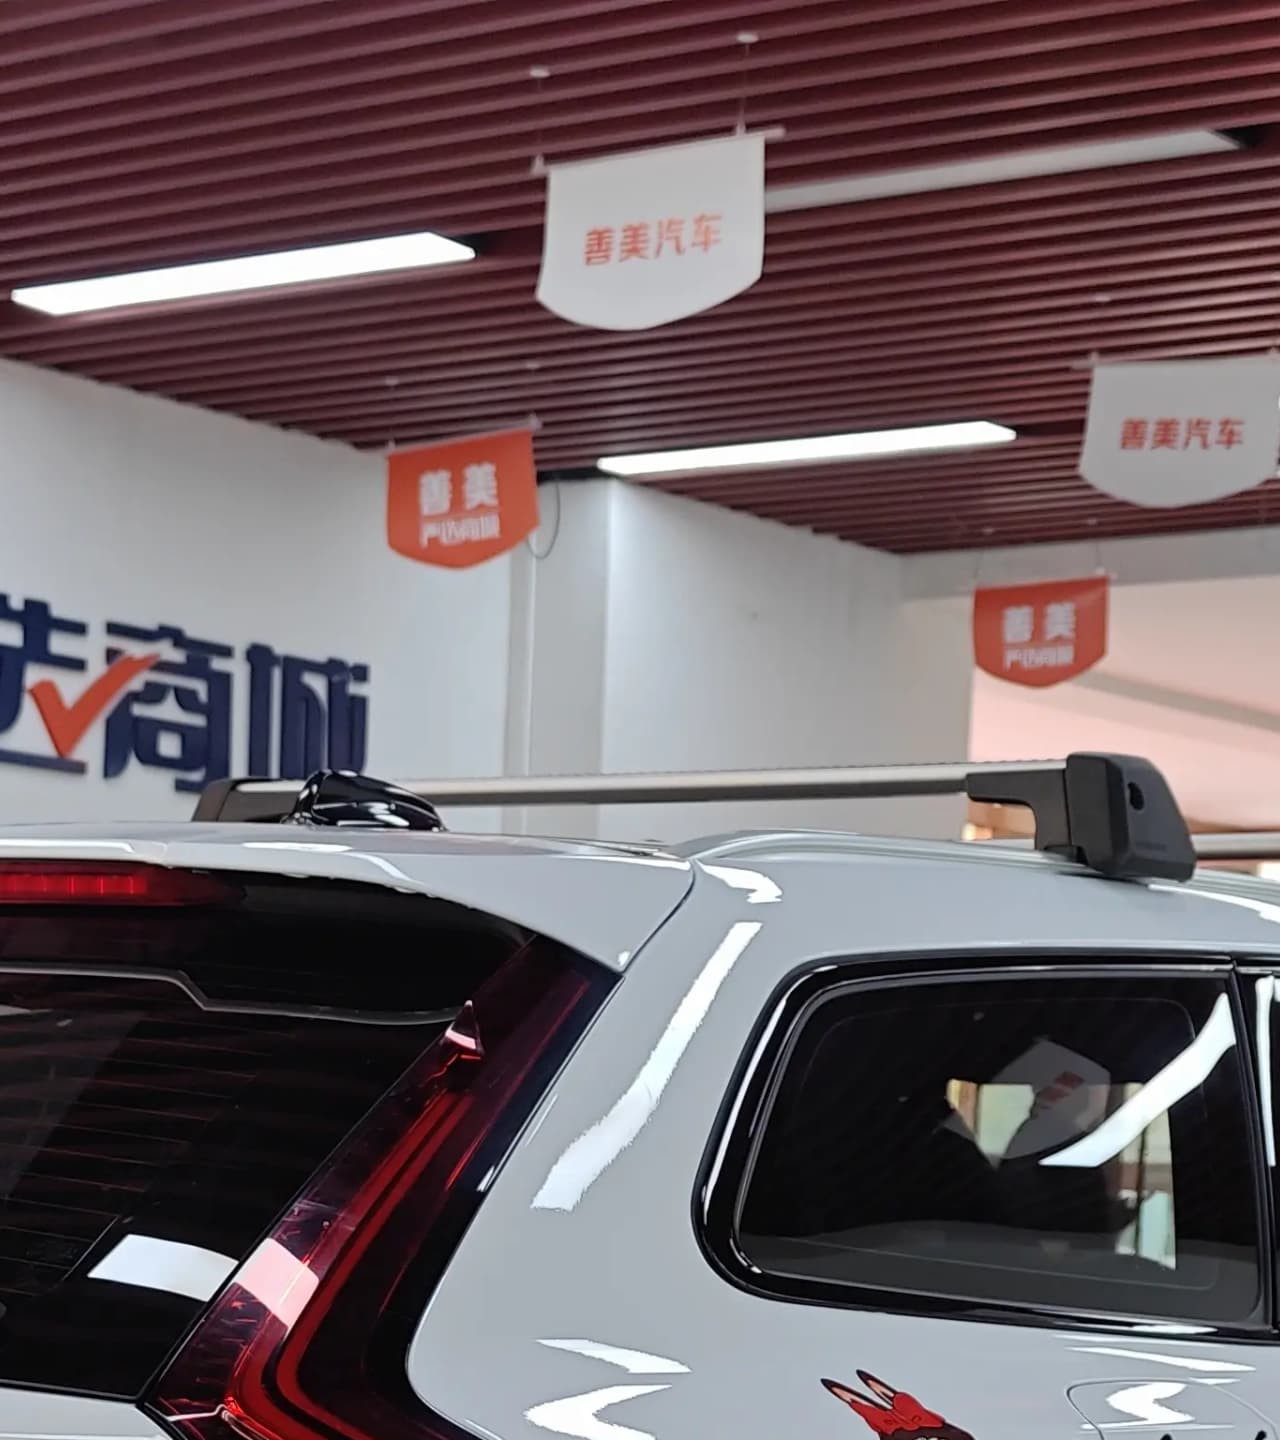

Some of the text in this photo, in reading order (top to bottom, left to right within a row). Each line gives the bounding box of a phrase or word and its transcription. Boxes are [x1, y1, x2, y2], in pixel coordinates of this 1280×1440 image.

[584, 212, 723, 266] 善美汽车
[1120, 417, 1245, 450] 善美汽车
